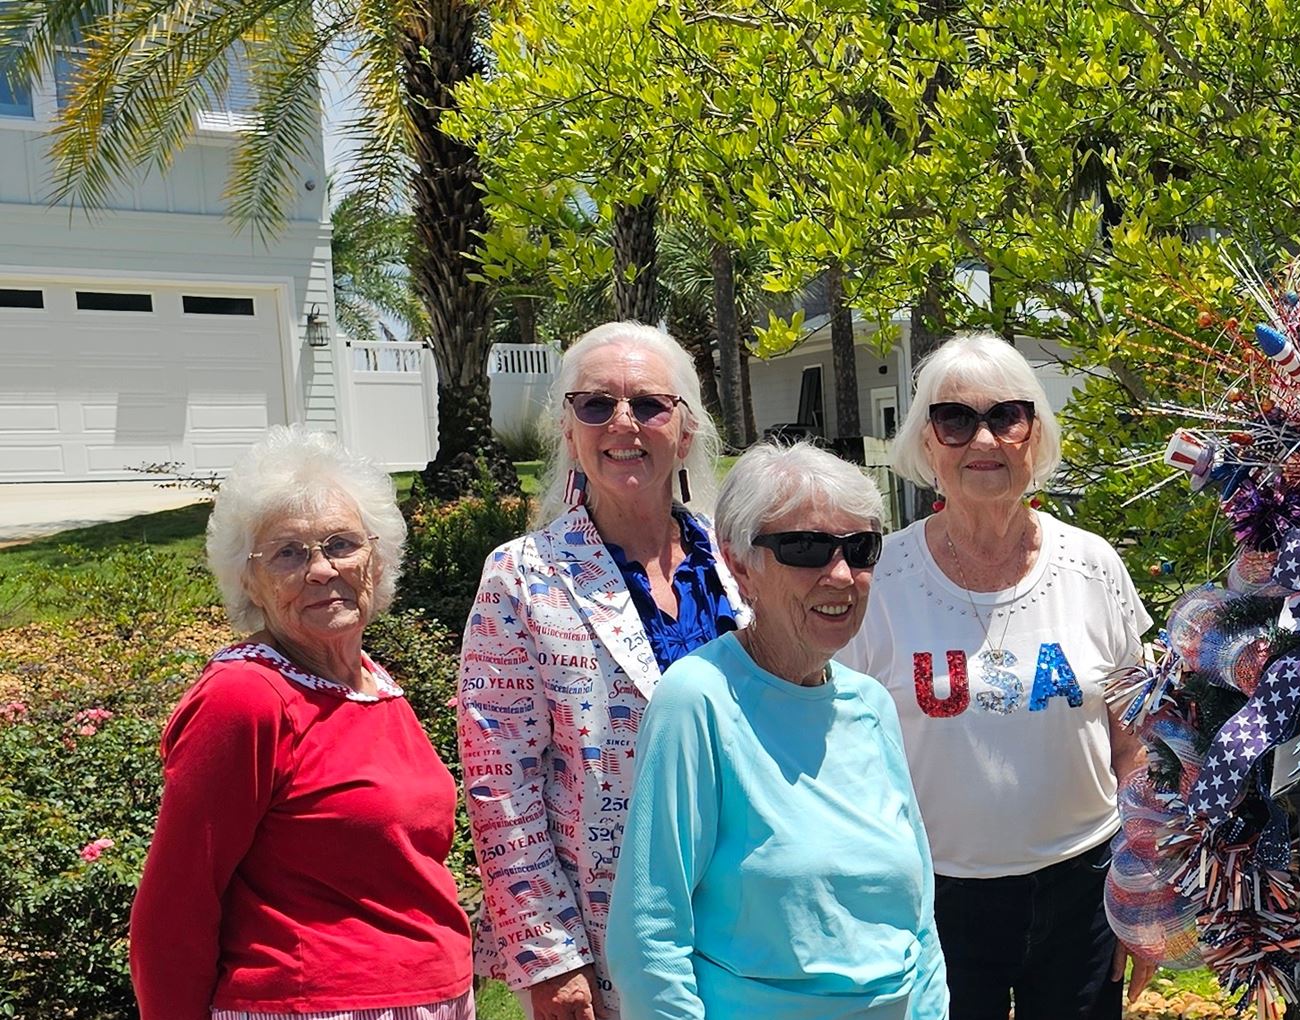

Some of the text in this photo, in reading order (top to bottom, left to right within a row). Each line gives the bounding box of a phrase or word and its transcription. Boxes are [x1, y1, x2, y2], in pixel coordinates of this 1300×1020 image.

[551, 654, 598, 670] YEARS
[462, 678, 535, 693] 250 YEARS
[913, 643, 1083, 718] USA
[468, 764, 513, 777] YEARS
[481, 844, 506, 864] 250
[508, 921, 552, 944] YEARS
